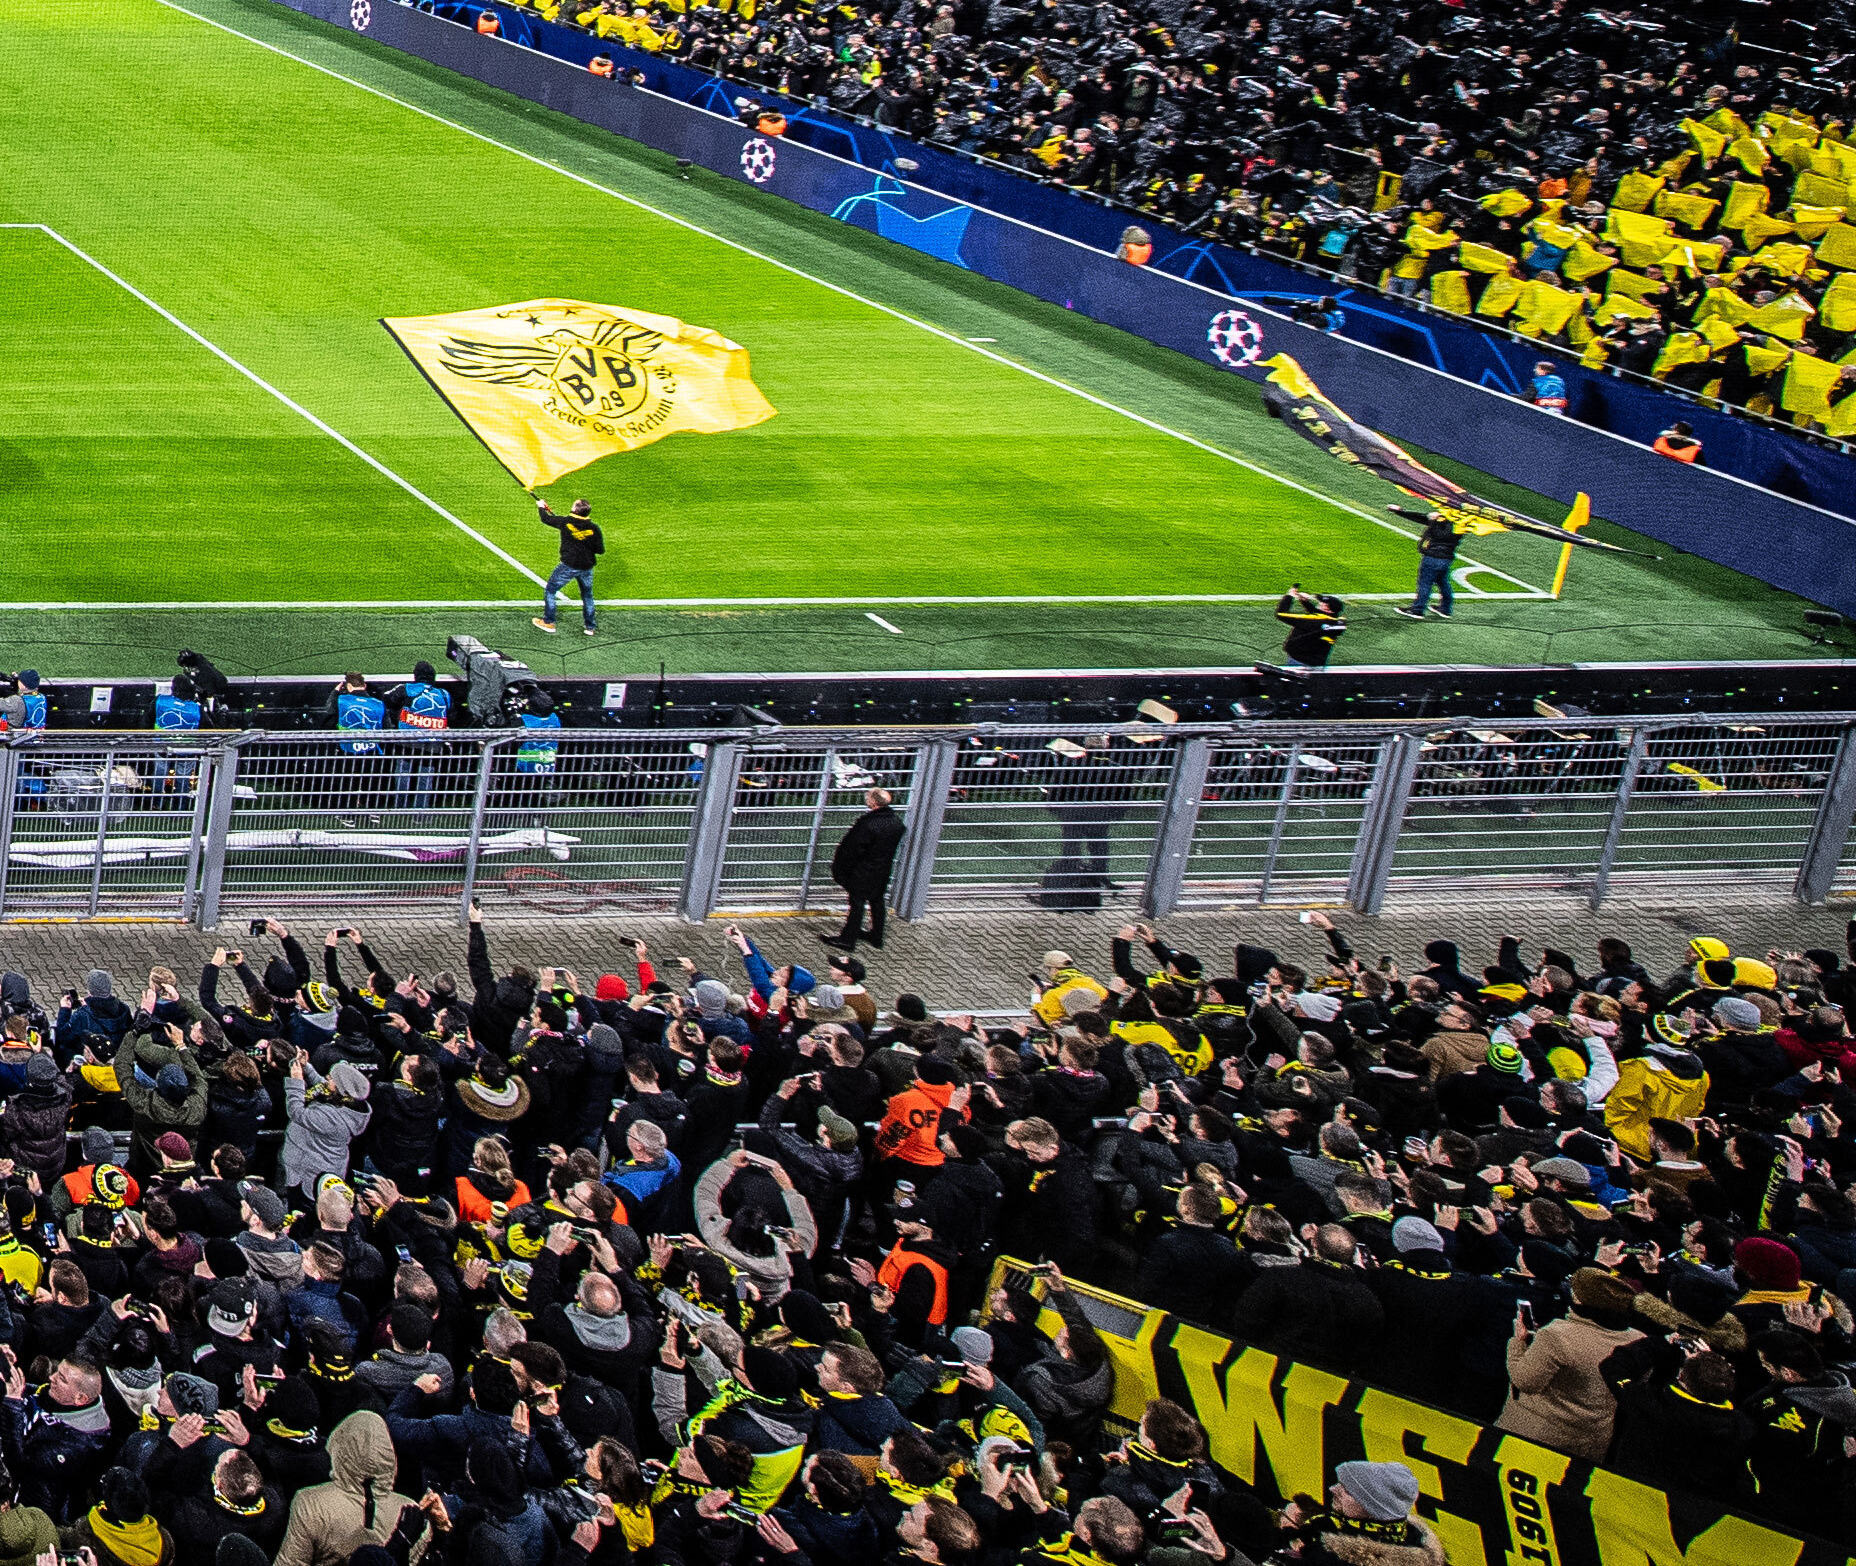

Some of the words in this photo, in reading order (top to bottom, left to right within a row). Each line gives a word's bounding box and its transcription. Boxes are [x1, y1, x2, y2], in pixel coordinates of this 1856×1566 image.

[560, 348, 637, 407] BVB
[600, 390, 625, 412] 09
[406, 713, 445, 729] PHOTO
